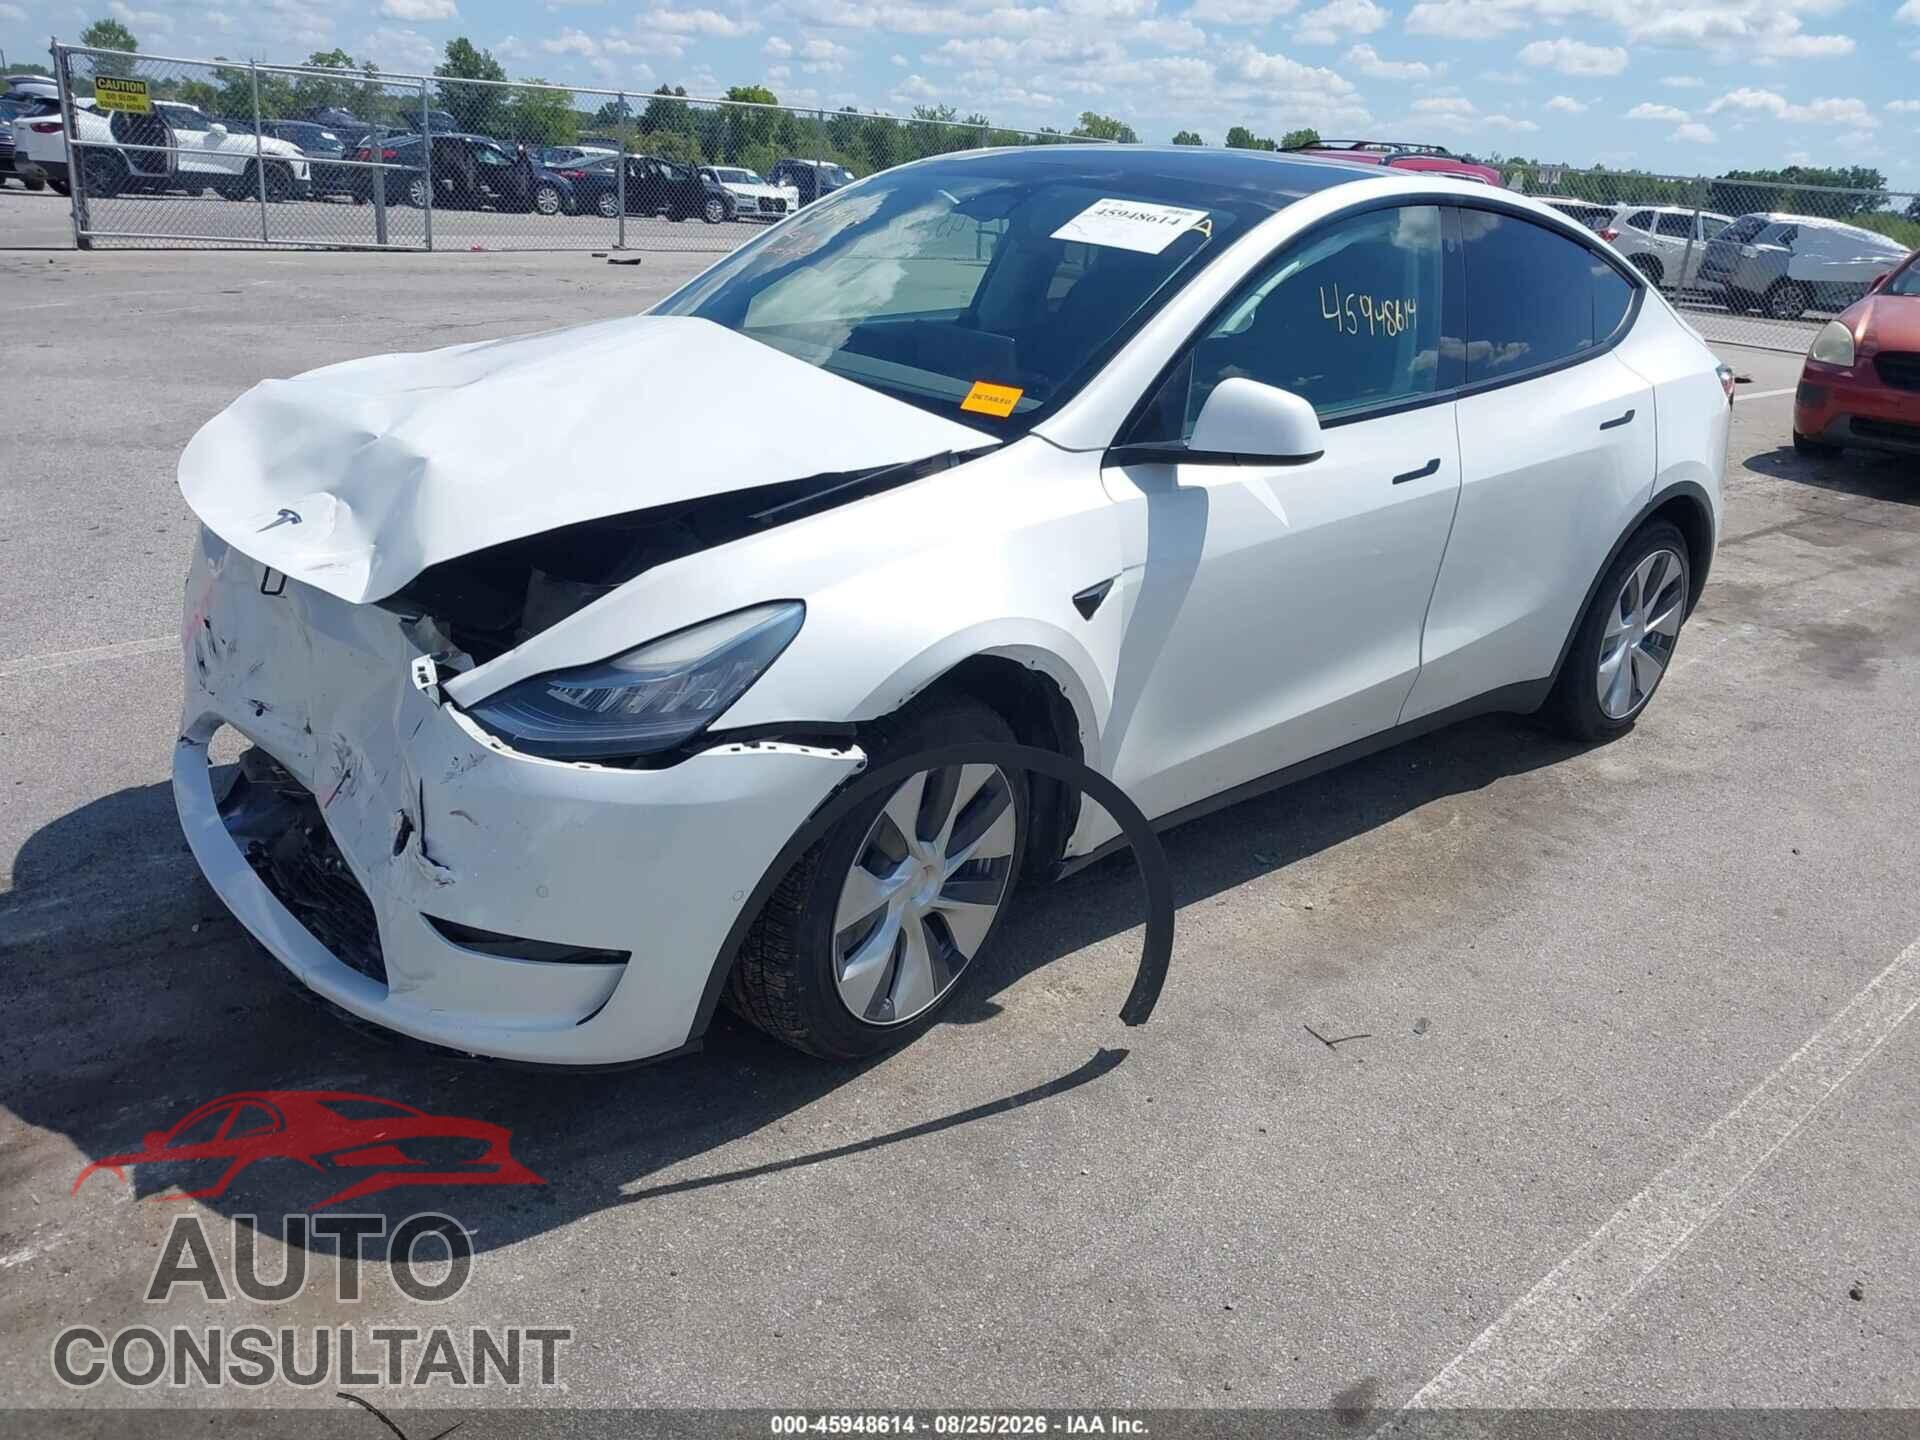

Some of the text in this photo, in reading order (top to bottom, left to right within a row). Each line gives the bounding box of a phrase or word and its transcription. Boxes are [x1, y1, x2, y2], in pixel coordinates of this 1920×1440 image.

[97, 78, 145, 93] CAUTION
[1094, 208, 1182, 226] 45948614
[1319, 282, 1417, 337] 45948614
